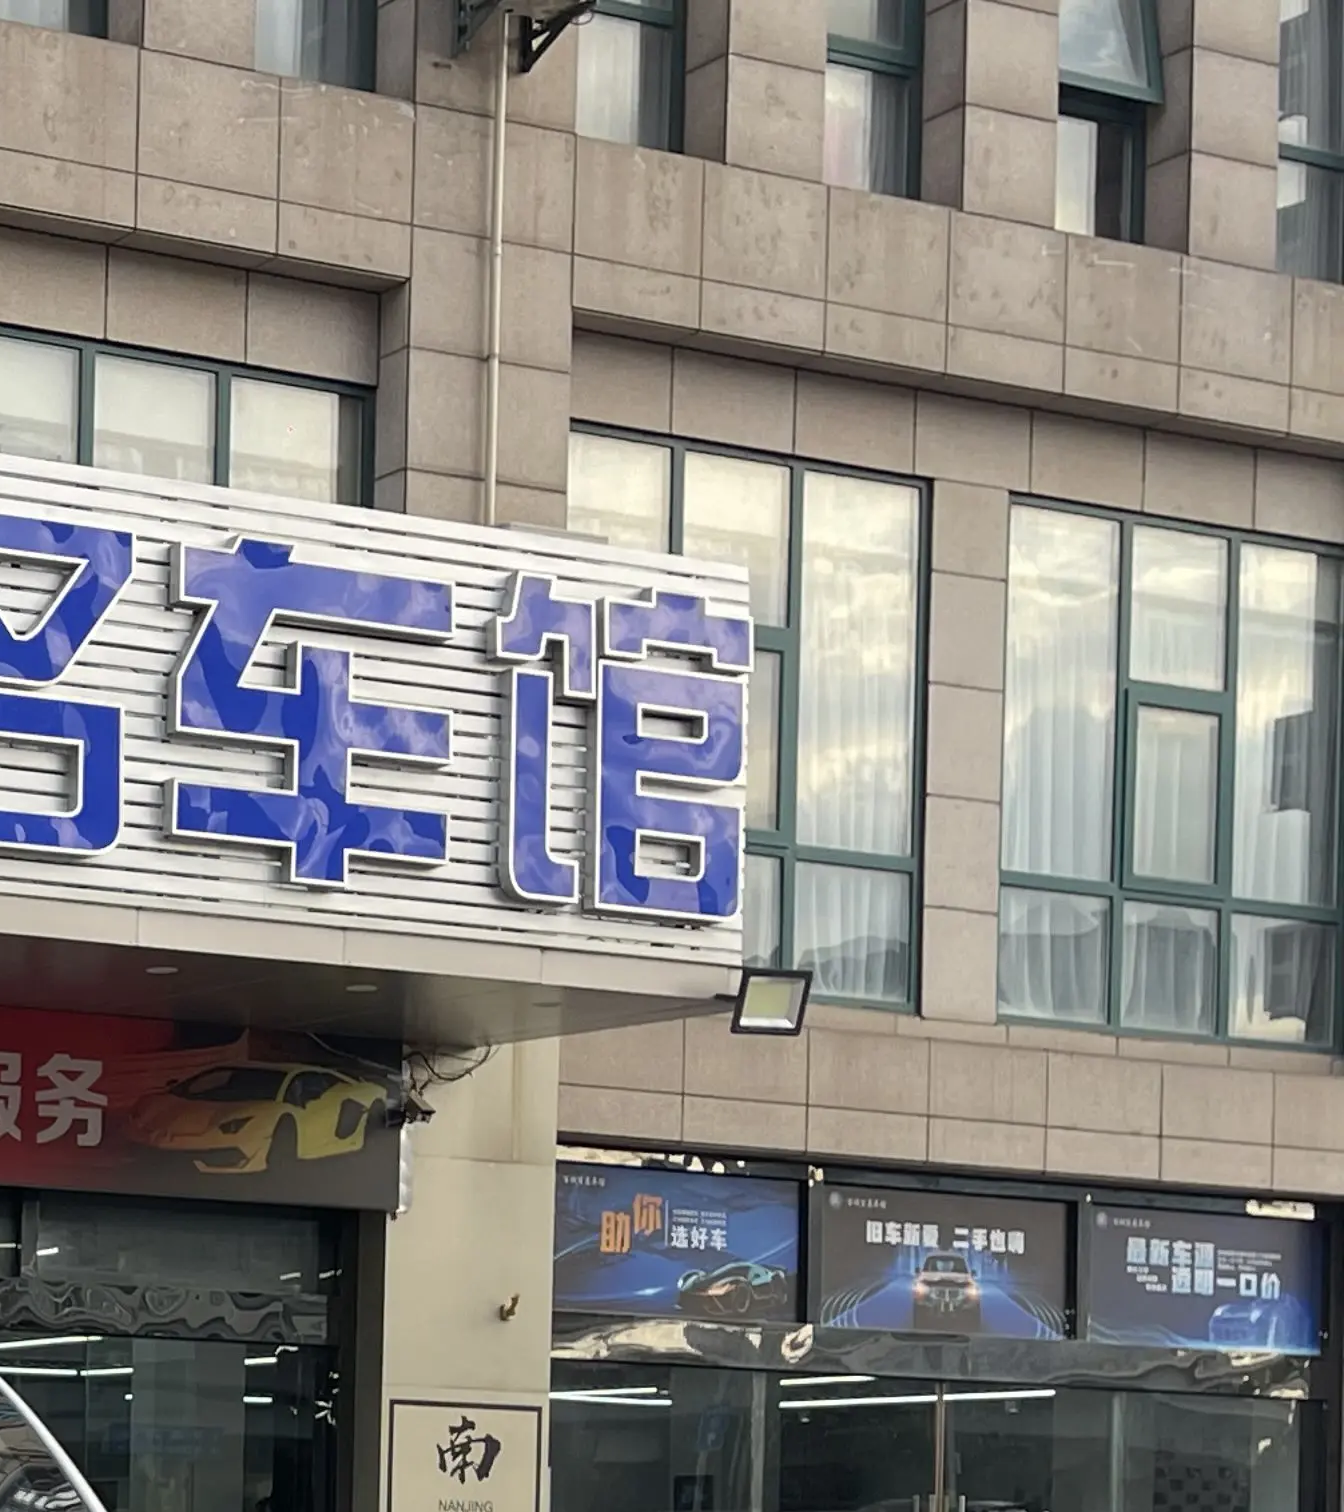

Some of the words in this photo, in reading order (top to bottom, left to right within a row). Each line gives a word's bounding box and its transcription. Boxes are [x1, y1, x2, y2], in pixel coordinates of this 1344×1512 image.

[670, 1224, 729, 1251] 选好车
[436, 1415, 502, 1485] 南
